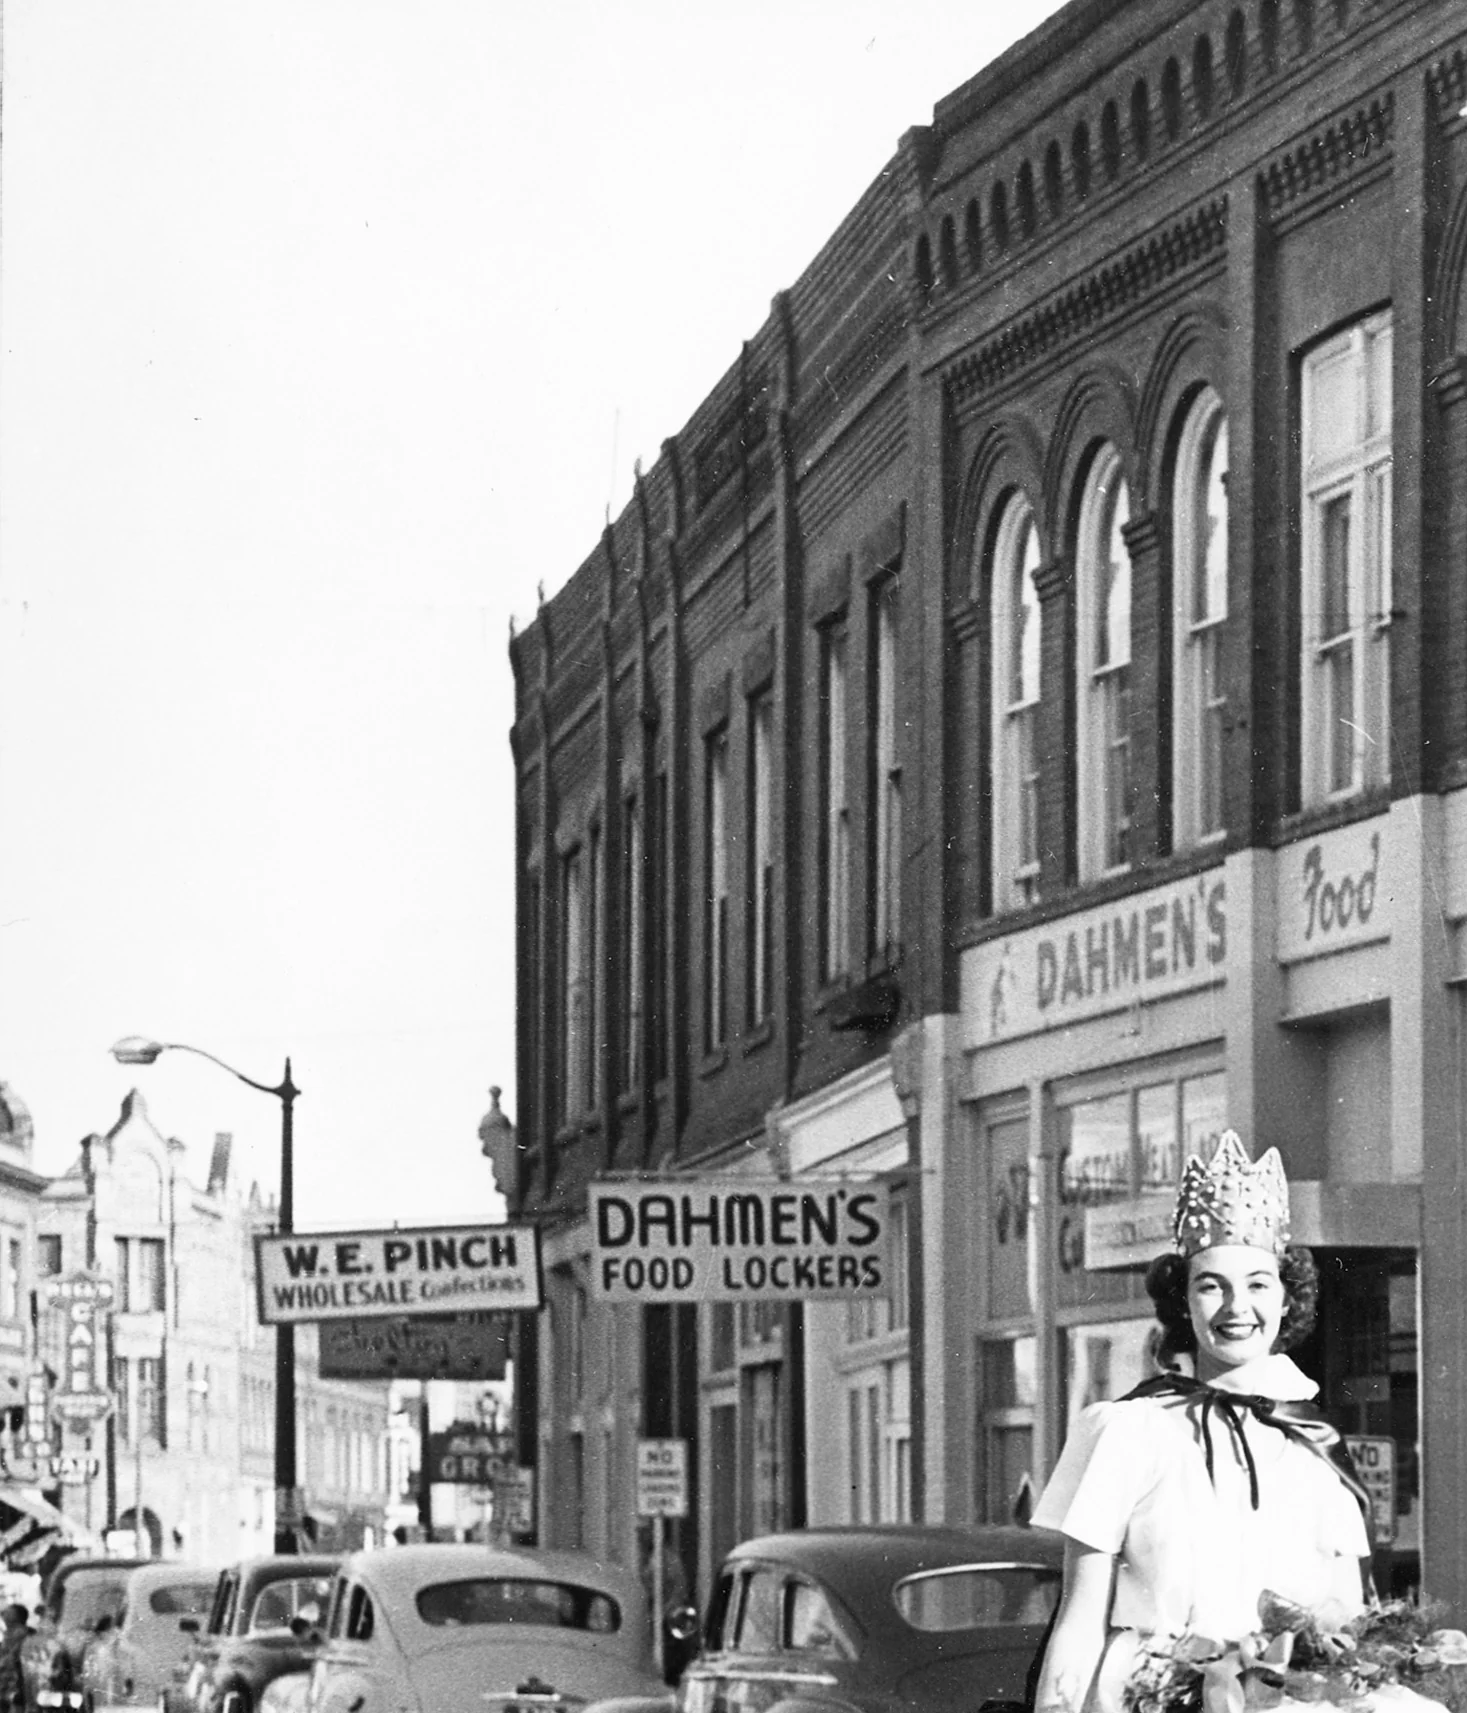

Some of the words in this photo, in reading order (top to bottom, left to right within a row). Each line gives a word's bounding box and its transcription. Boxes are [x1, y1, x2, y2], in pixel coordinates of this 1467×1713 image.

[1037, 875, 1227, 1011] DAHMEN'S
[1303, 831, 1380, 942] Food
[599, 1189, 881, 1247] DAHMEN'S
[384, 1235, 518, 1273] PINCH
[602, 1257, 694, 1292] FOOD
[723, 1254, 881, 1291] LOCKERS
[273, 1279, 414, 1309] WHOLESALE
[645, 1450, 673, 1465] NO
